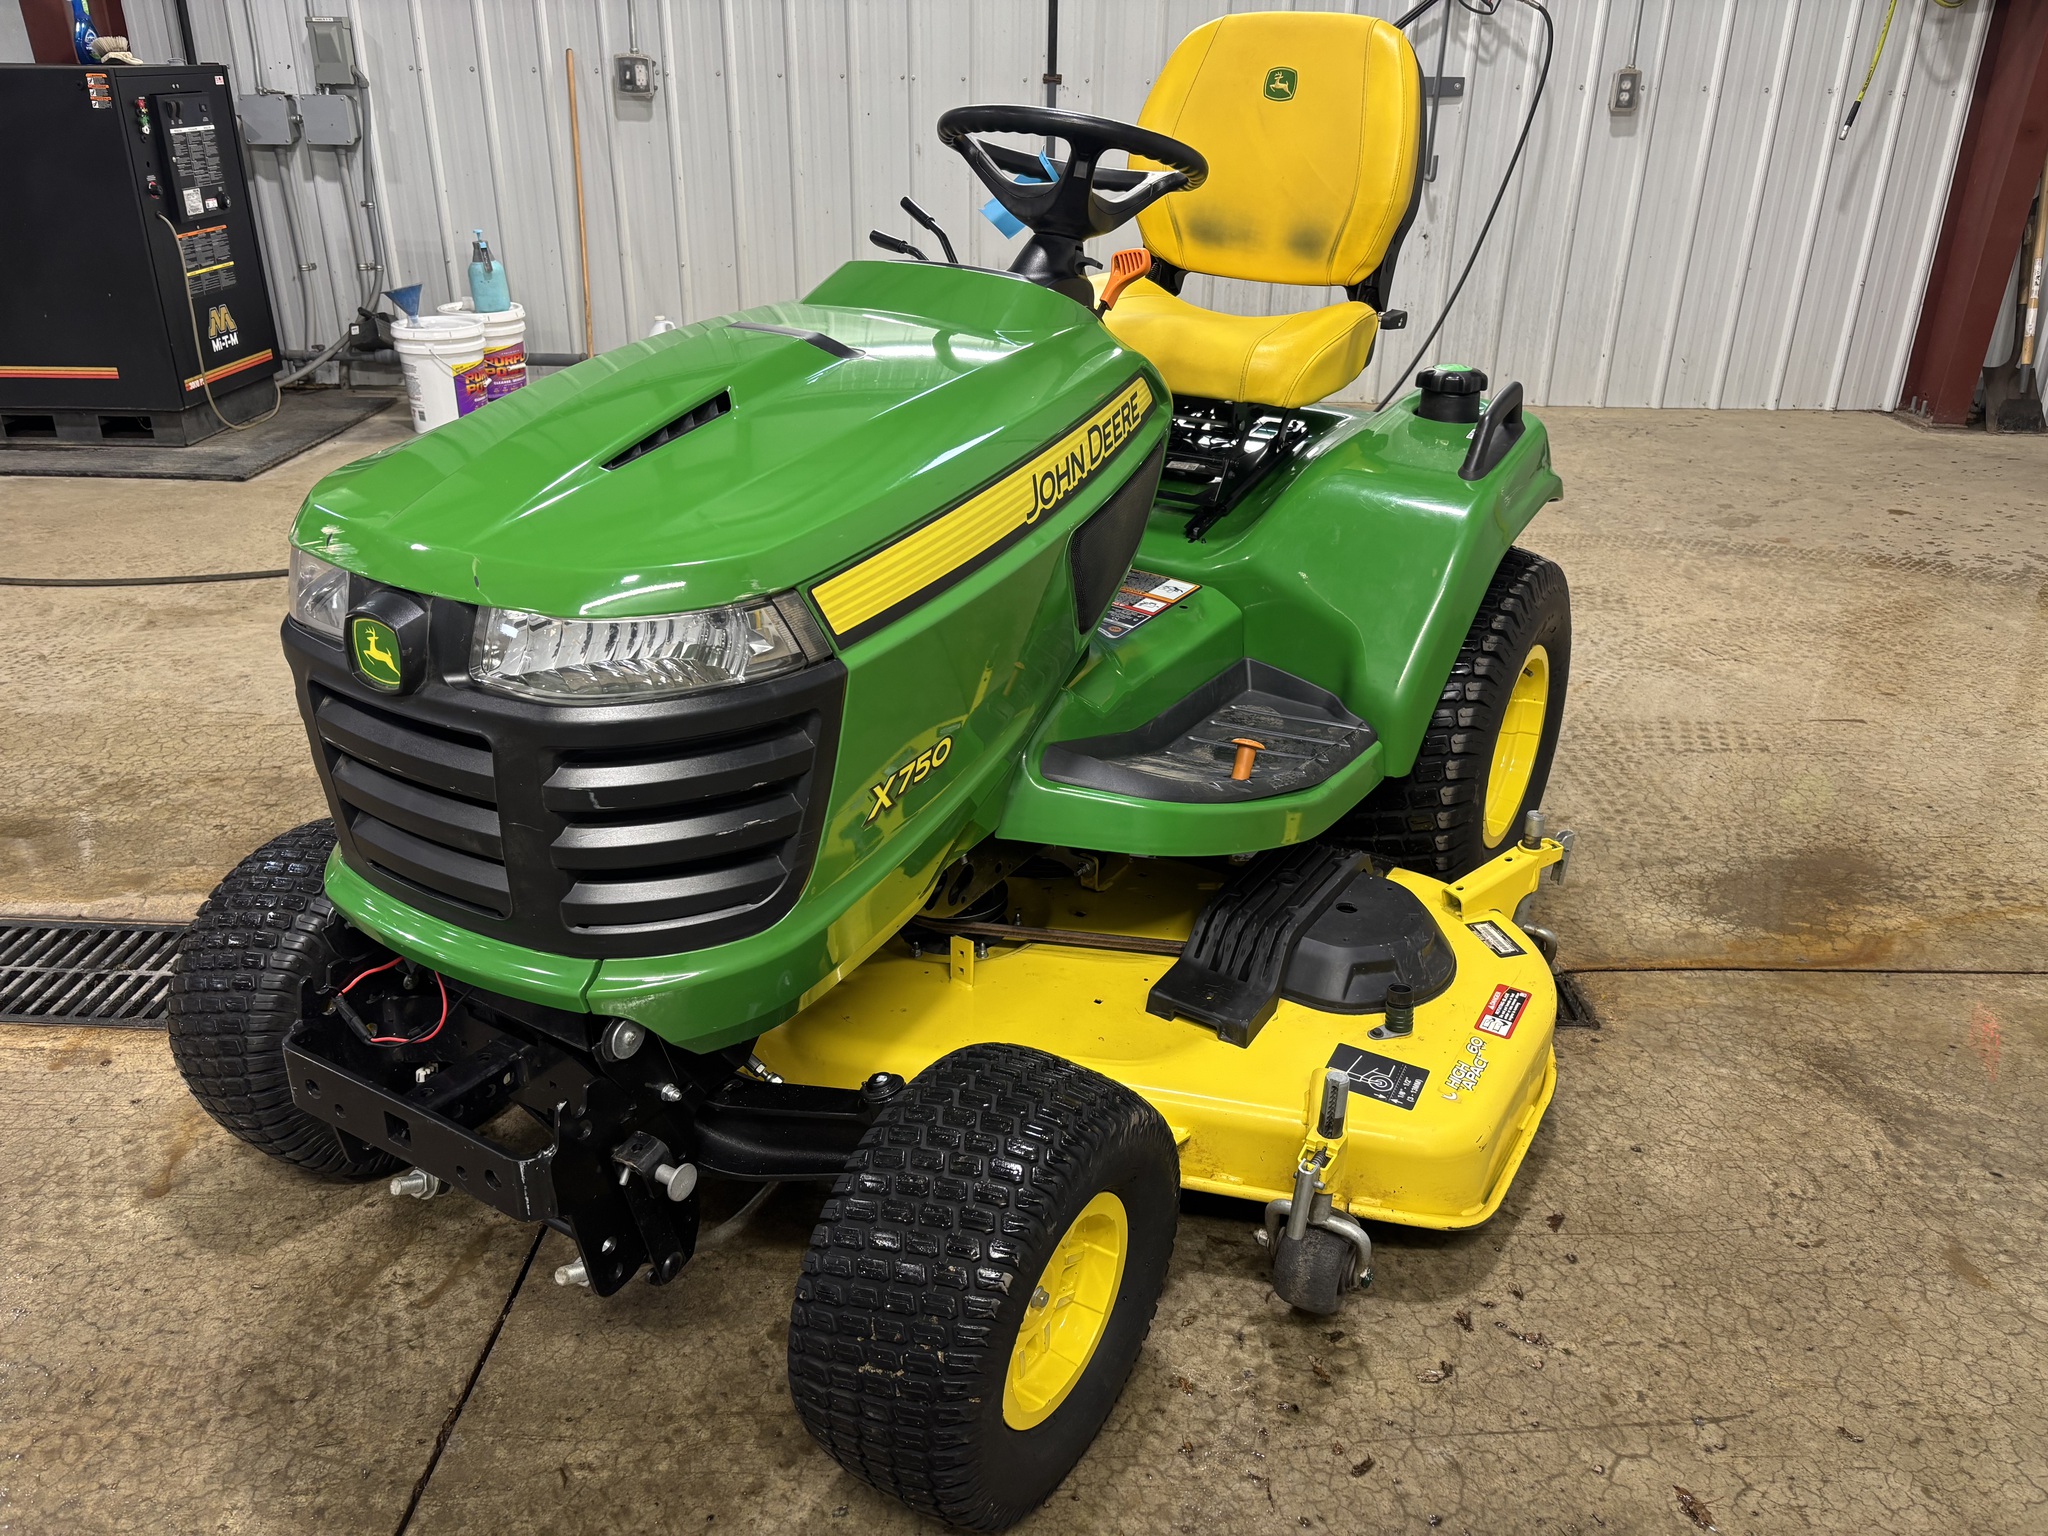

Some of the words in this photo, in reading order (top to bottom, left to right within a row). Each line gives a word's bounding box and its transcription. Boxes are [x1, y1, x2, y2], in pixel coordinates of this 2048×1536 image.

[1026, 442, 1087, 523] JOHN
[1087, 390, 1141, 469] DEERE
[865, 735, 952, 824] X750
[1445, 1059, 1471, 1090] HIGH
[1466, 1036, 1484, 1055] 60
